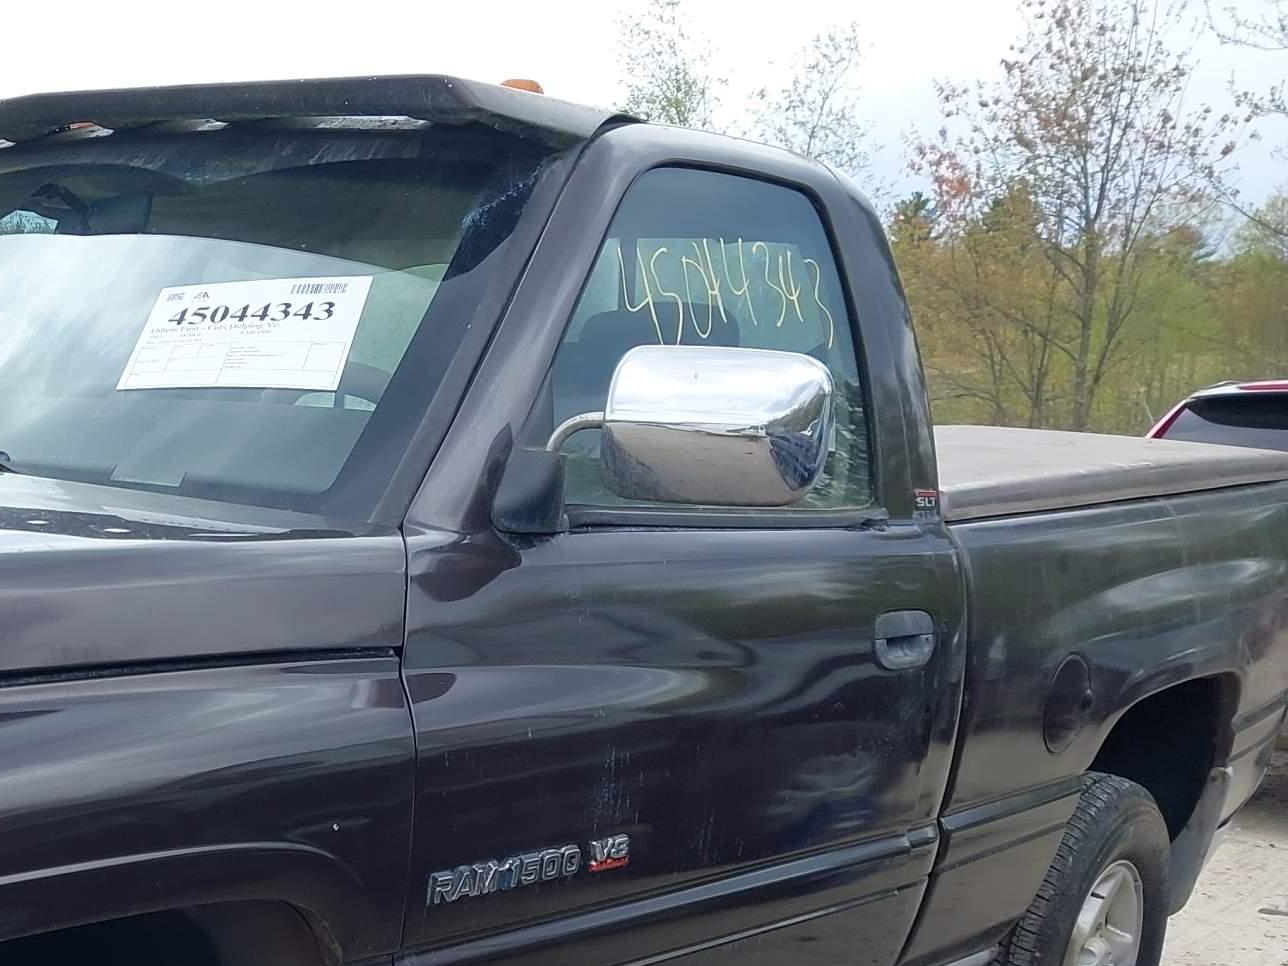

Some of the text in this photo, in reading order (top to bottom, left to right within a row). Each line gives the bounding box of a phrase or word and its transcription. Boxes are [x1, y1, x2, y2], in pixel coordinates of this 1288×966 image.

[168, 301, 336, 325] 45044343
[916, 496, 935, 506] SLT
[426, 833, 630, 905] RAM 1500 V8
